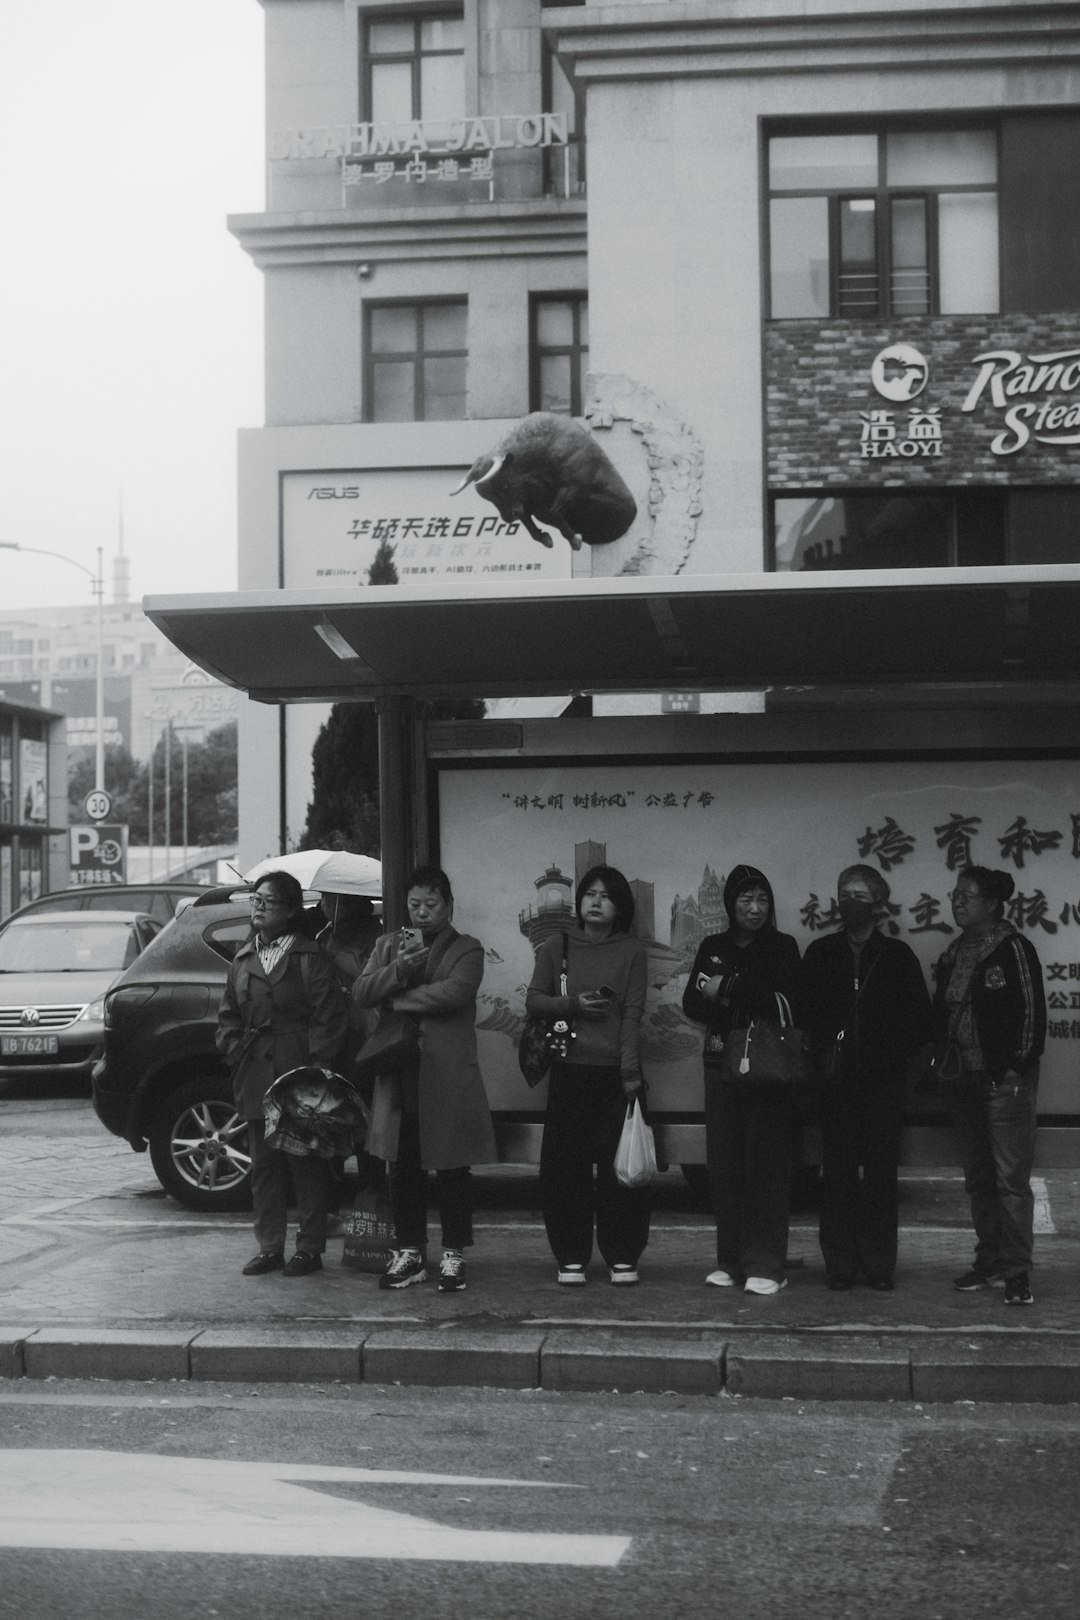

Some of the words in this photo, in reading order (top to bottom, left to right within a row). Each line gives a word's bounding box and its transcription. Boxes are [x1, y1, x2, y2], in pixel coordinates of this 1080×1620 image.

[445, 111, 570, 151] SALON
[860, 407, 942, 441] 浩益
[860, 441, 942, 457] HAOYI
[307, 486, 360, 500] ASUS
[71, 827, 99, 865] P
[856, 813, 1080, 872] 培育和
